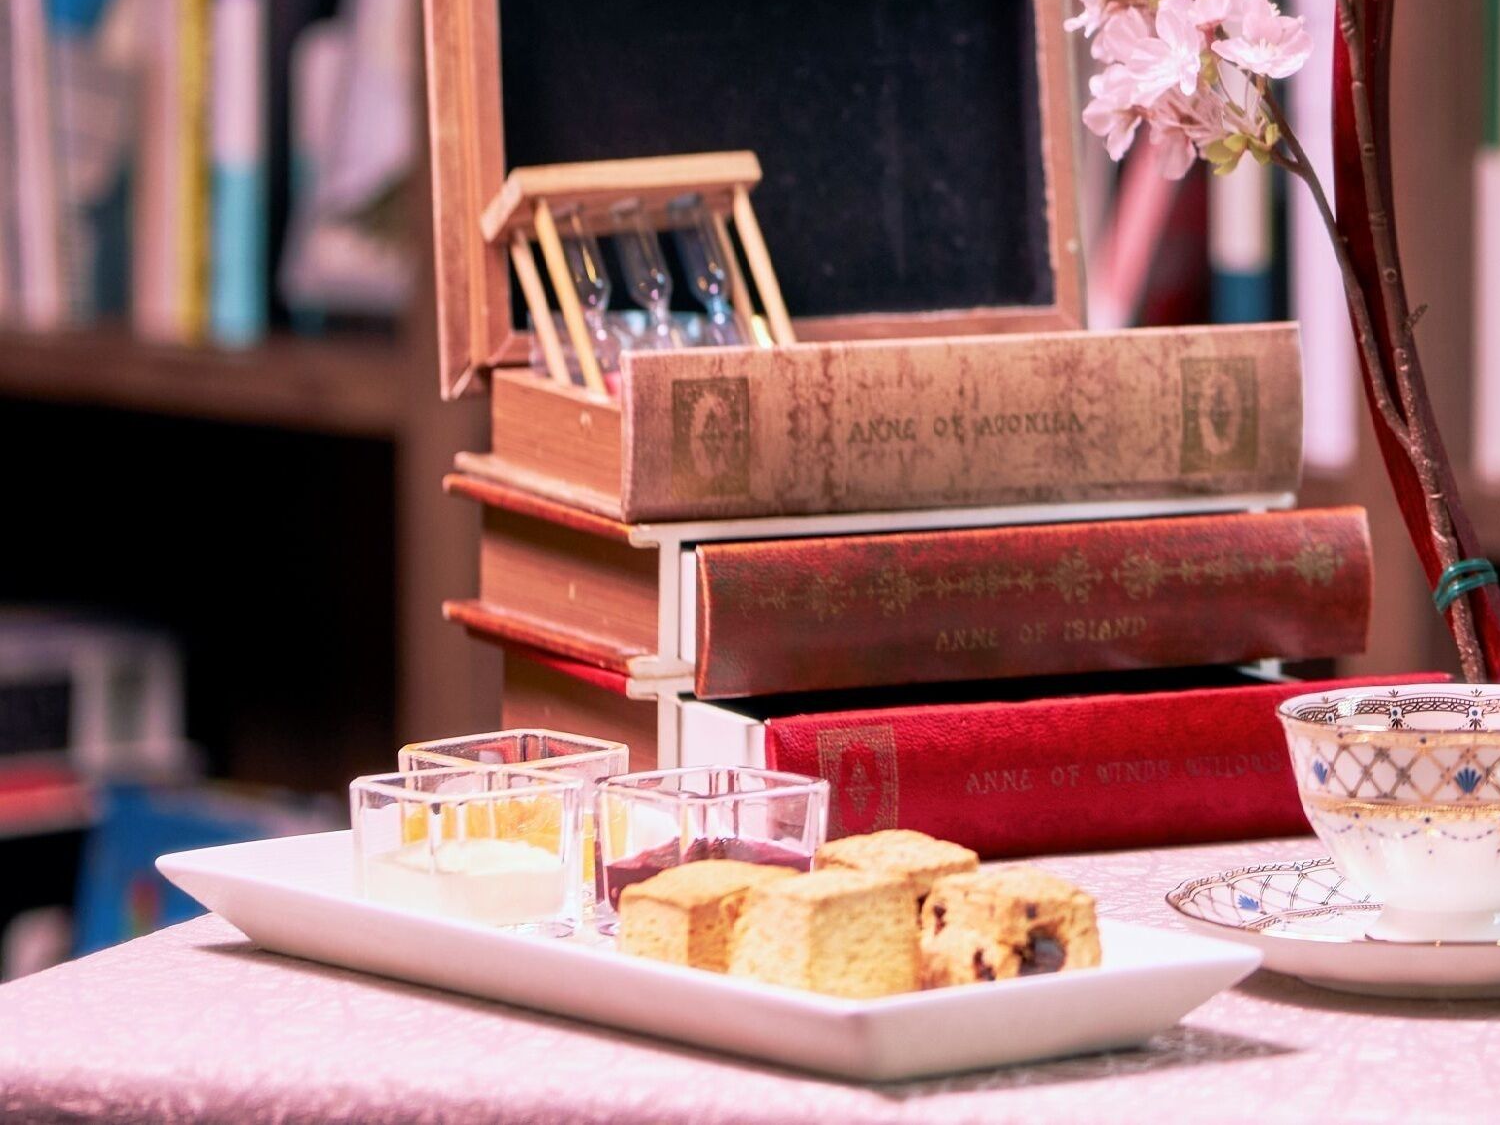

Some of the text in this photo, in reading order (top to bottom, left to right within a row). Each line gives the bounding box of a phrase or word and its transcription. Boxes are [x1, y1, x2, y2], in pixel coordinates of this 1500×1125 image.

[847, 418, 917, 445] ANNE
[932, 415, 965, 442] OF
[935, 616, 1148, 652] ANNE OF ISLAND
[965, 768, 1034, 796] ANNE
[1050, 763, 1080, 788] OF
